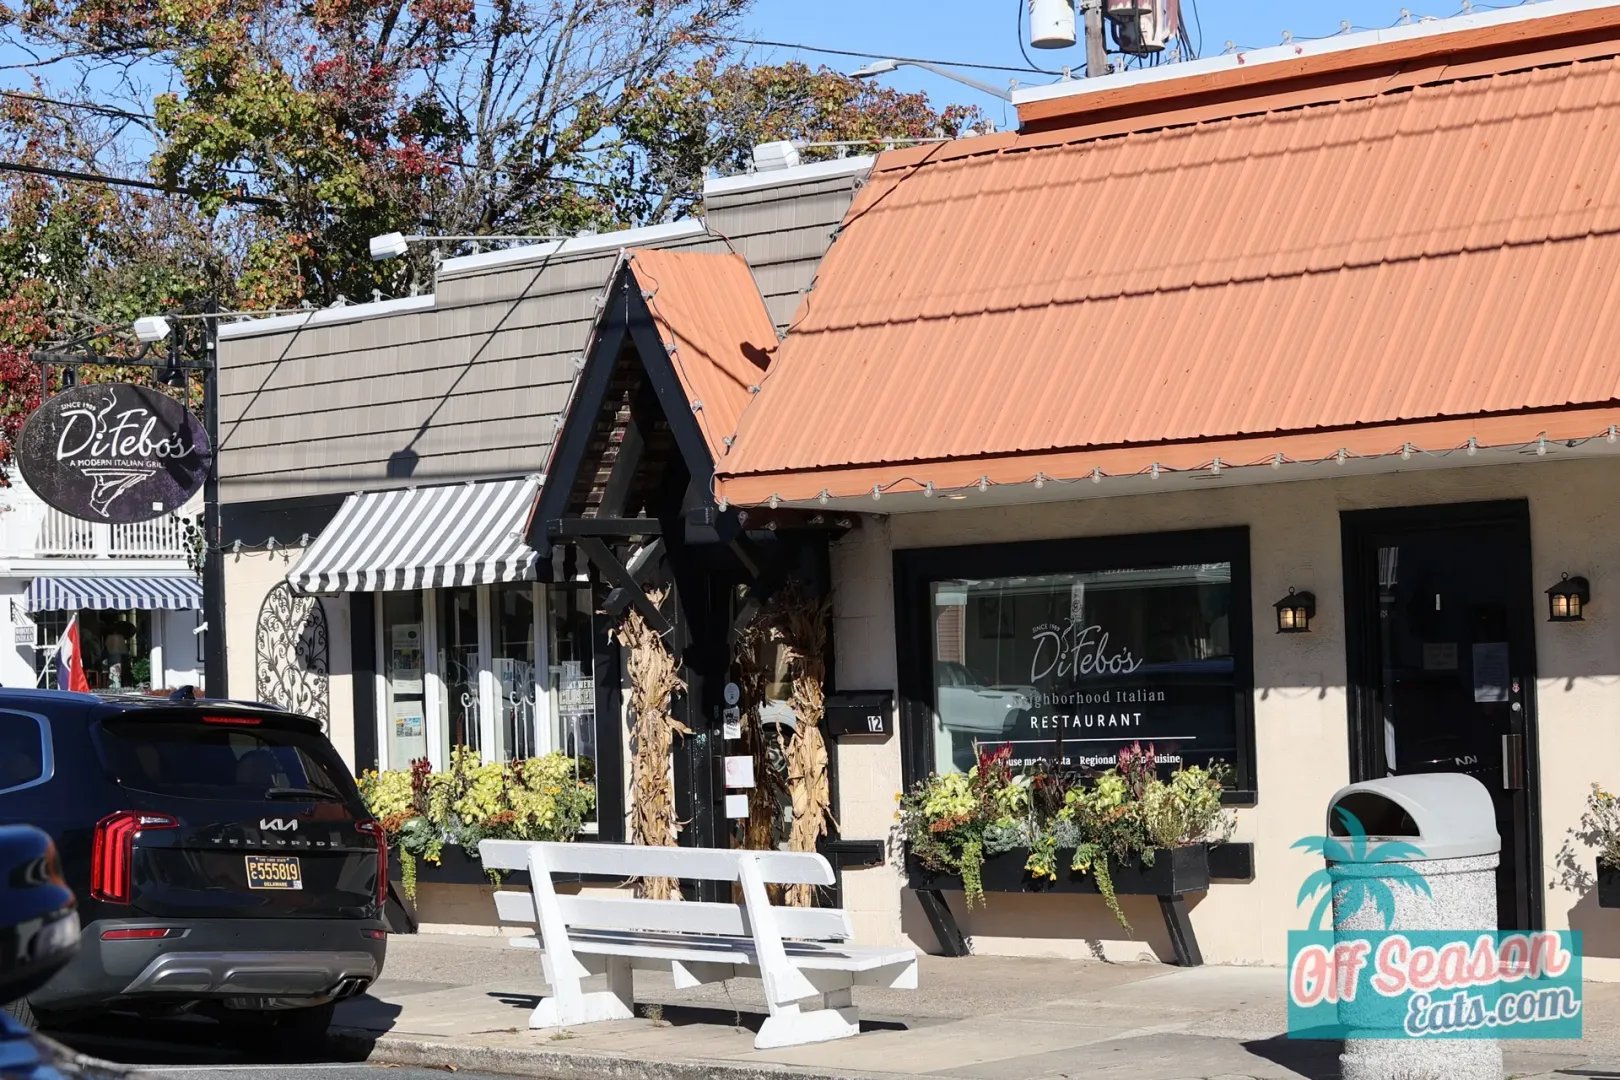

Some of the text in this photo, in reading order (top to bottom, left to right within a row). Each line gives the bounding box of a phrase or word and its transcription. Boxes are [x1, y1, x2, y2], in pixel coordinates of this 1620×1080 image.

[60, 401, 81, 410] SINCE
[69, 459, 76, 467] A
[77, 459, 112, 467] MODERN
[114, 459, 144, 468] ITALIAN
[1032, 623, 1049, 633] SINCE
[1116, 689, 1166, 703] Italian
[869, 717, 882, 731] 12
[1030, 713, 1142, 729] RESTAURANT
[997, 757, 1022, 767] use
[1080, 755, 1116, 767] Regional
[1150, 753, 1181, 764] uisine
[259, 818, 298, 831] KIA
[211, 838, 338, 847] TELLURIDE
[257, 863, 298, 880] 555819
